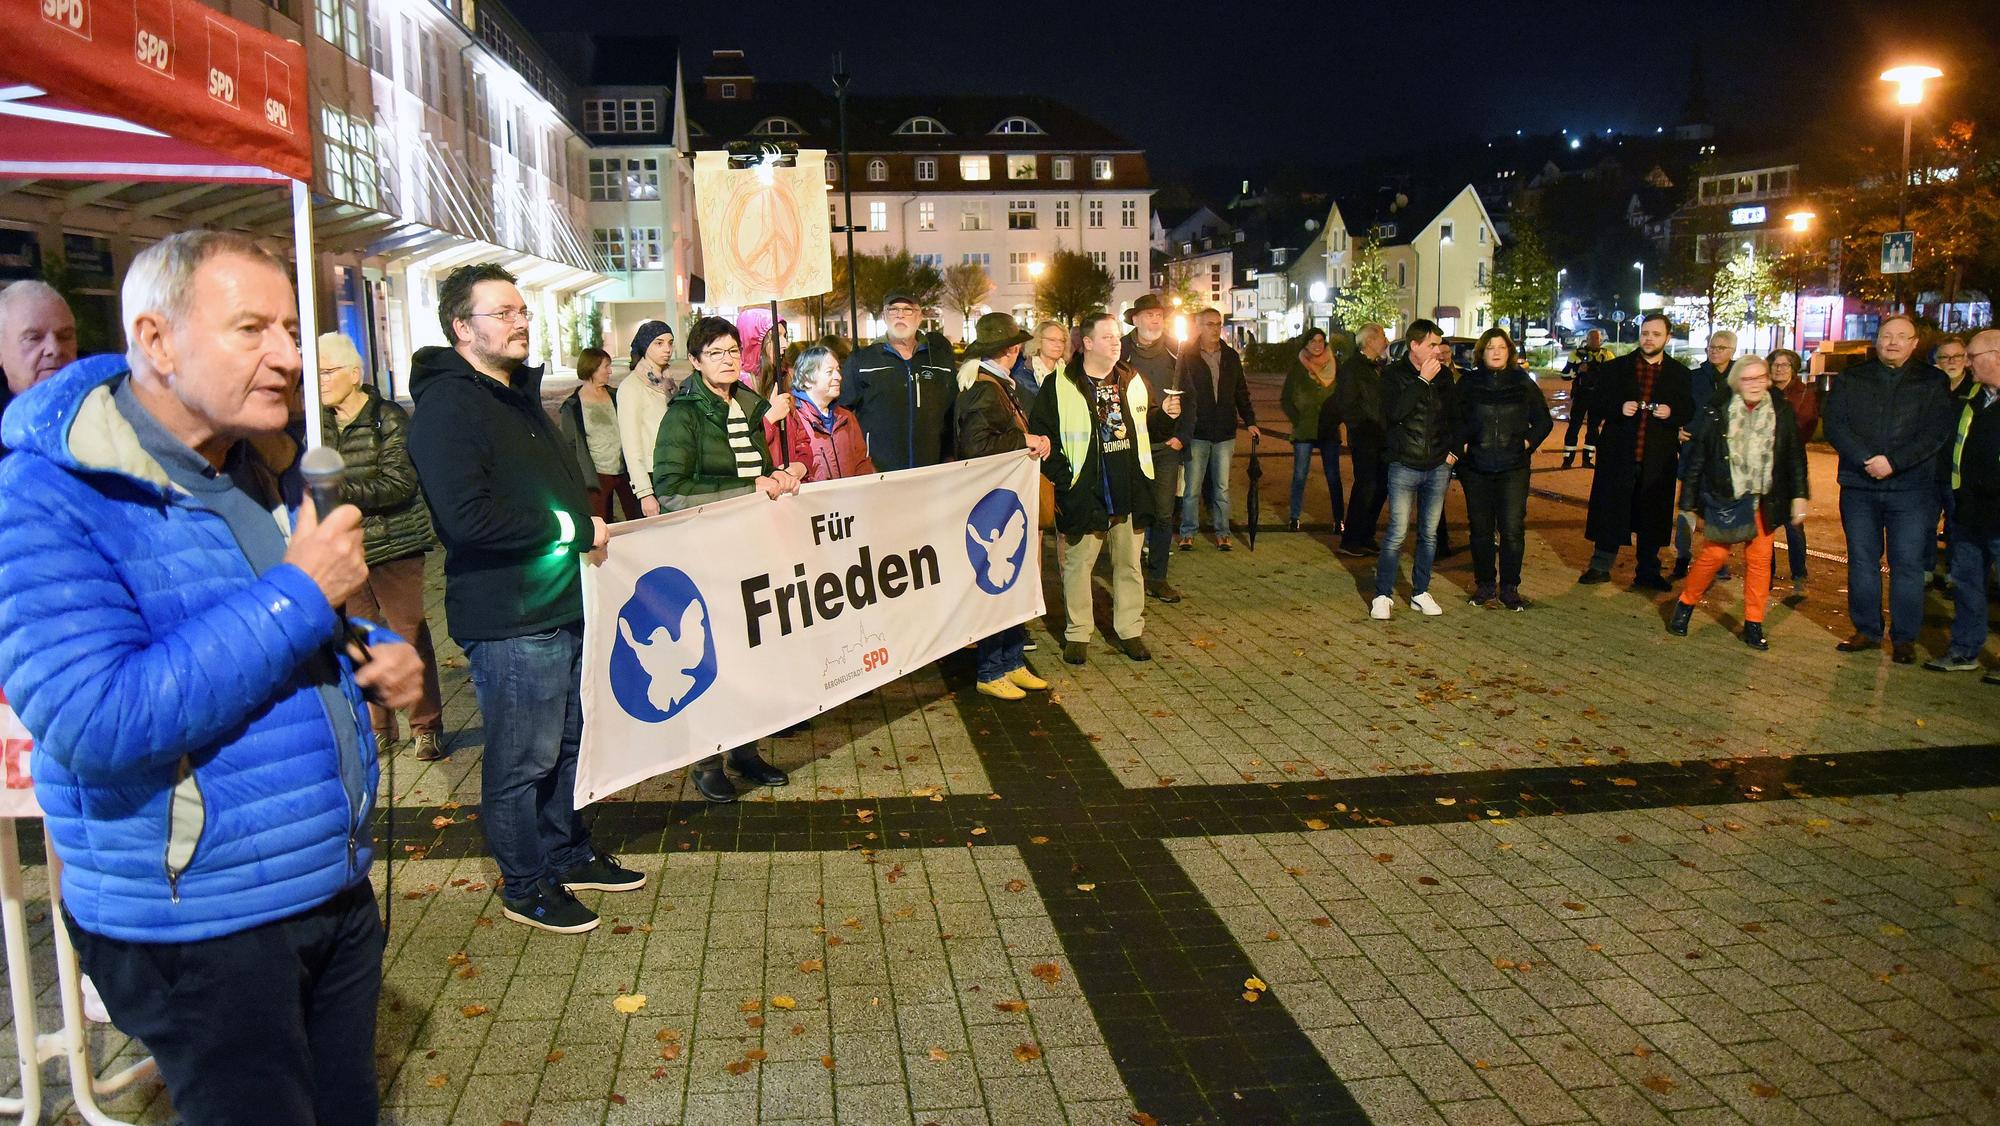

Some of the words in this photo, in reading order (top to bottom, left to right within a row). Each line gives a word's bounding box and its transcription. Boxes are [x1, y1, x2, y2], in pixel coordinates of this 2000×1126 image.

[137, 30, 169, 70] SPD
[209, 68, 234, 103] SPD
[266, 98, 287, 128] SPD
[811, 512, 855, 546] Für
[740, 544, 941, 649] Frieden
[863, 647, 889, 672] SPD
